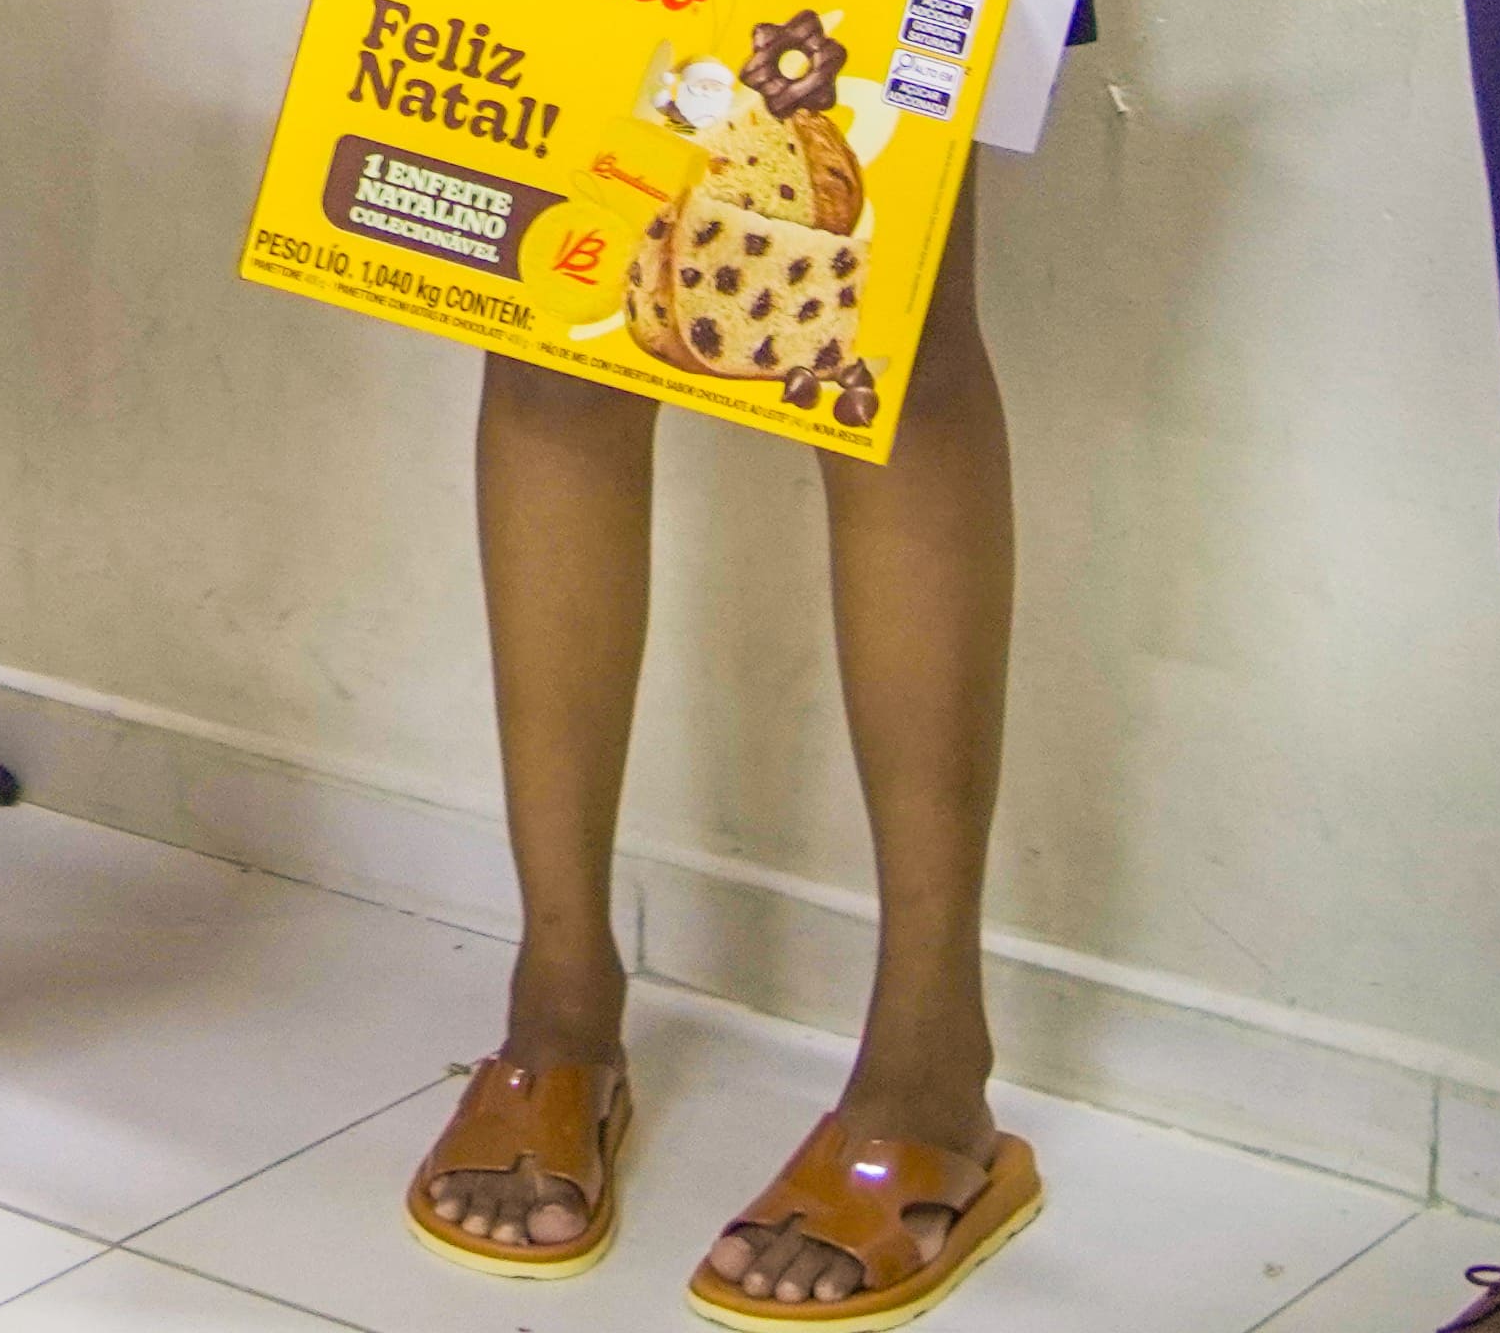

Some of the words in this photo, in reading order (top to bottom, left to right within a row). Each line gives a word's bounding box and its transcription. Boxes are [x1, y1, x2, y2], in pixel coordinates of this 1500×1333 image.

[346, 49, 561, 160] Natal!
[355, 176, 508, 241] NATALINO
[362, 152, 385, 180] 1
[386, 159, 514, 217] ENFEITE
[349, 205, 500, 265] COLECIONÁVEL
[253, 228, 311, 265] PESO
[314, 243, 353, 279] LÍQ.
[361, 260, 415, 295] 1,040
[416, 273, 443, 309] kg
[445, 284, 537, 333] CONTÉM:
